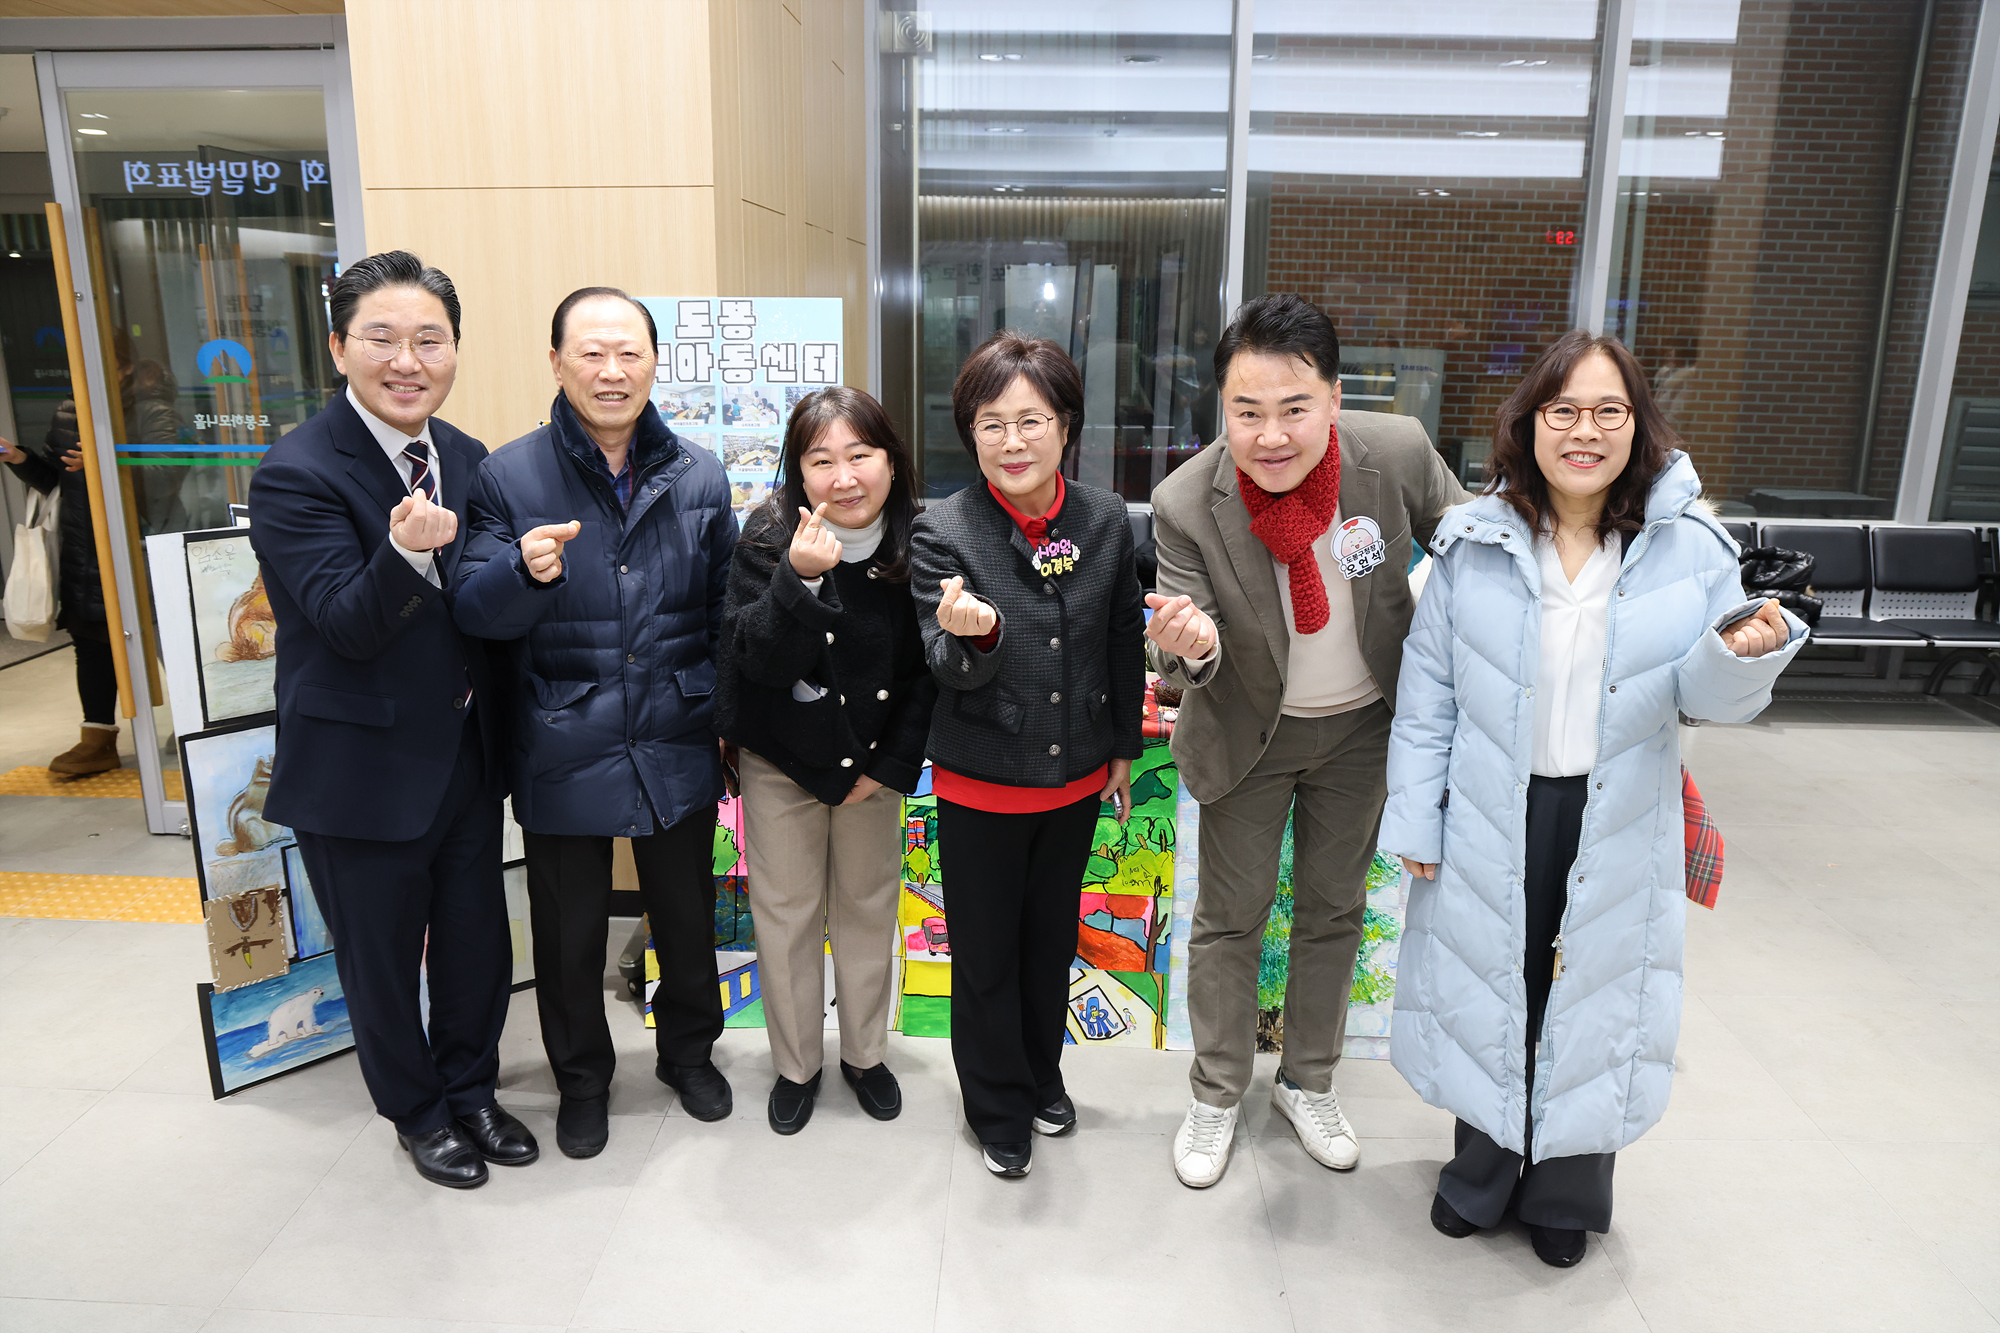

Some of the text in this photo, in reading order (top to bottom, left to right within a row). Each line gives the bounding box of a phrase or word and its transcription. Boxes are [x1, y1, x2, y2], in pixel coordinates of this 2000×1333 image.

[675, 300, 757, 340] 도봉
[1346, 544, 1377, 564] 도봉구청장
[1041, 555, 1074, 577] 이경숙
